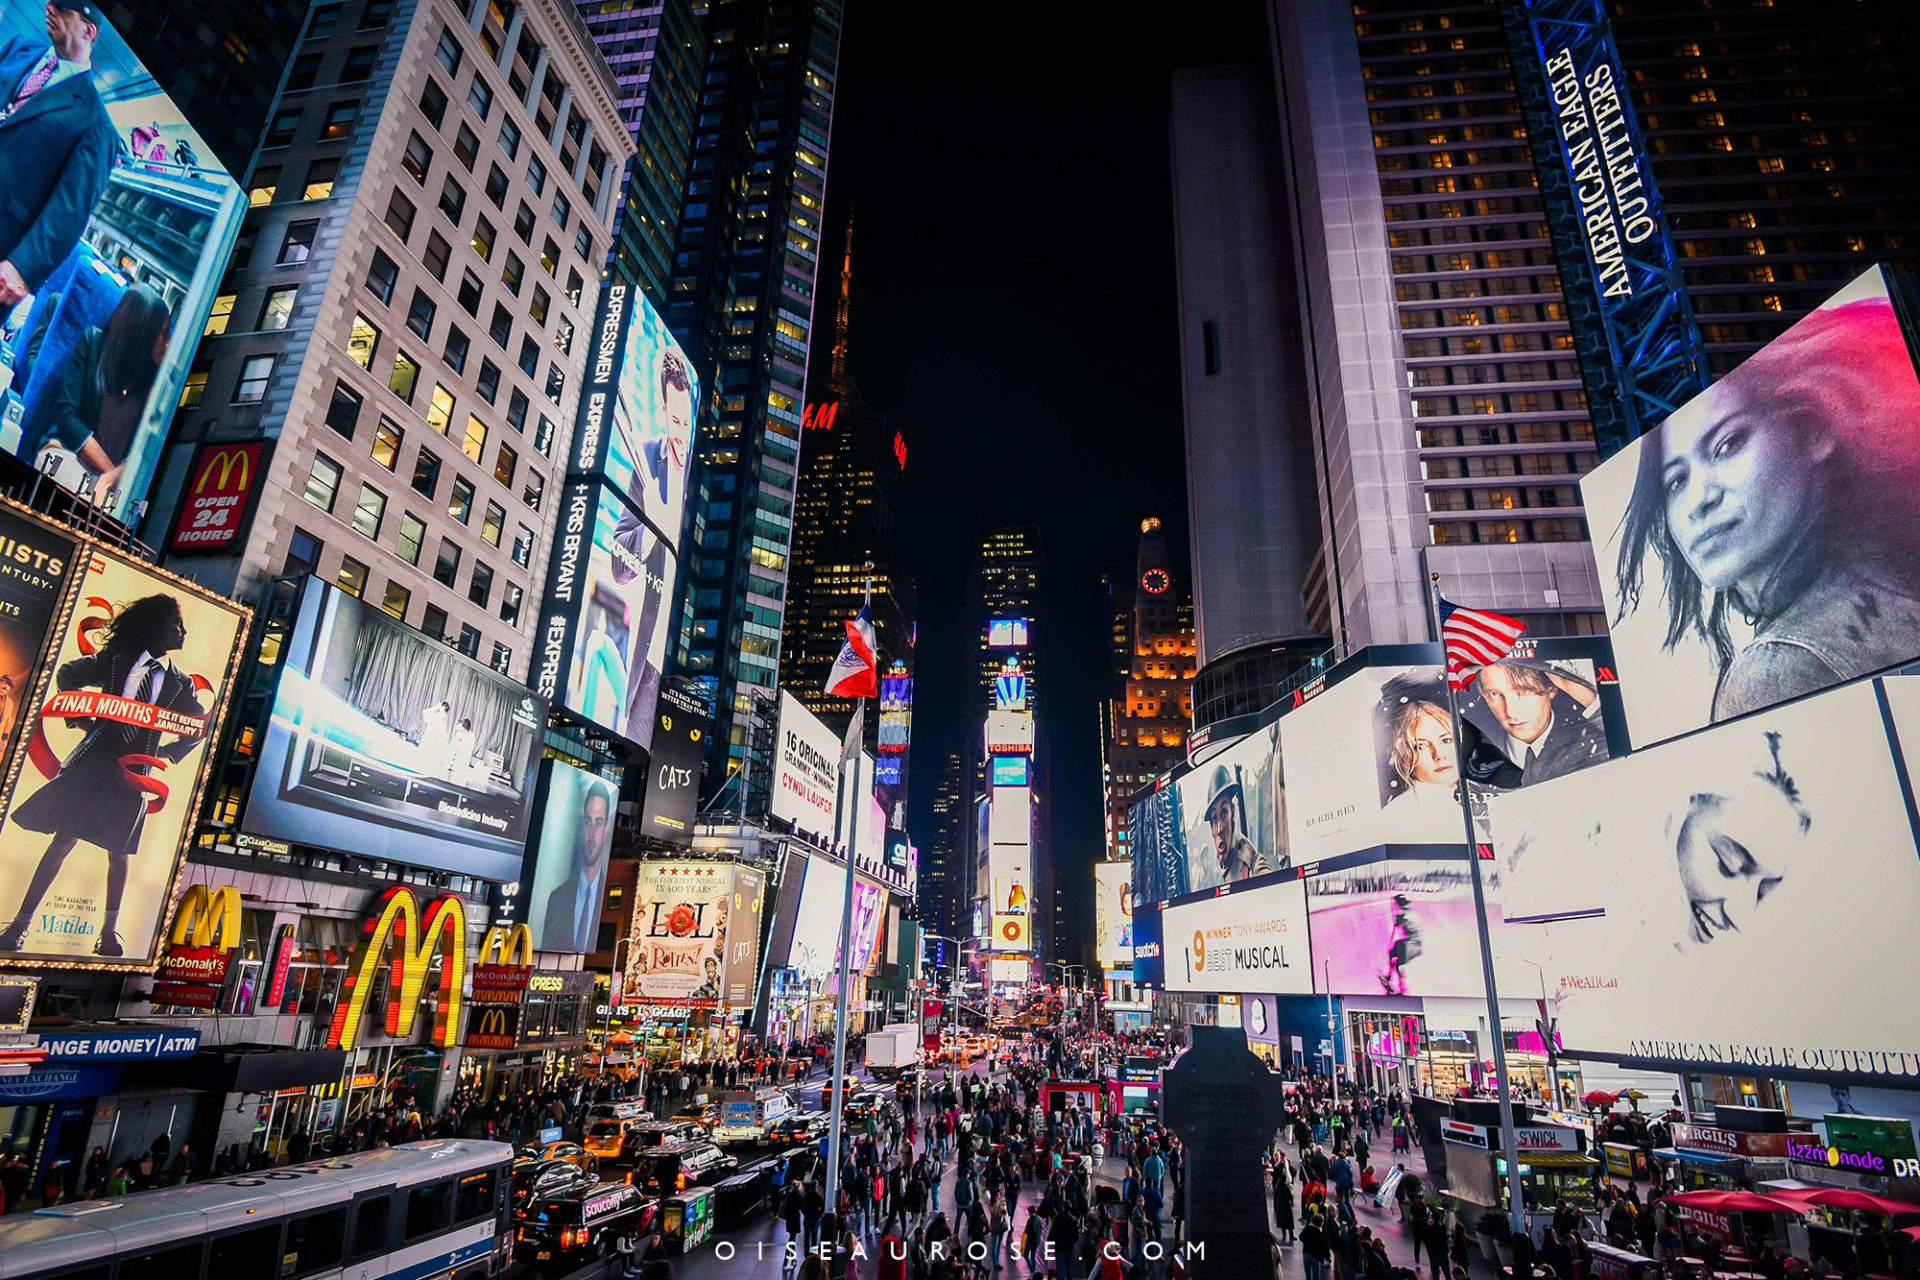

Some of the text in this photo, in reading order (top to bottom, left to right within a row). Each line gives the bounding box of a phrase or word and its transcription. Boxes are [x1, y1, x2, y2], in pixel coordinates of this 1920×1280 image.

[1585, 63, 1654, 244] OUTFITTERS
[1546, 47, 1632, 298] AMERICAN EAGLE
[593, 285, 626, 384] EXPRESSMEN
[194, 495, 239, 508] OPEN
[193, 509, 229, 528] 24
[177, 529, 234, 543] HOURS
[554, 534, 581, 602] BRYANT
[537, 615, 567, 700] #EXPRES
[51, 695, 153, 724] FINAL MONTHS
[691, 699, 702, 707] AND
[153, 718, 196, 737] JANUARY
[157, 709, 205, 728] SEE IT BEFORE
[786, 729, 835, 781] 16 ORIGINAL
[989, 744, 1032, 752] TOSHIBA
[658, 764, 692, 791] CATS
[782, 772, 806, 799] CYNDI
[806, 787, 833, 815] LAUPER
[438, 800, 509, 832] Biomedicine Industry
[655, 885, 665, 893] IN
[37, 914, 95, 935] Matilda
[1206, 926, 1232, 939] WINNER
[1255, 918, 1287, 934] AWARDS
[733, 940, 751, 965] CATS
[1193, 929, 1206, 972] 9
[1207, 944, 1289, 972] BEST MUSICAL
[163, 956, 225, 971] McDonald's
[166, 968, 211, 978] Restaurant
[474, 971, 526, 980] McDonald's
[529, 976, 564, 991] PRESS
[40, 1037, 197, 1055] ANGE MONEY ATM
[1626, 1039, 1722, 1064] AMERICAN
[1728, 1043, 1797, 1068] EAGLE
[585, 1195, 620, 1218] saucony
[1678, 1205, 1730, 1233] IRGIL'S
